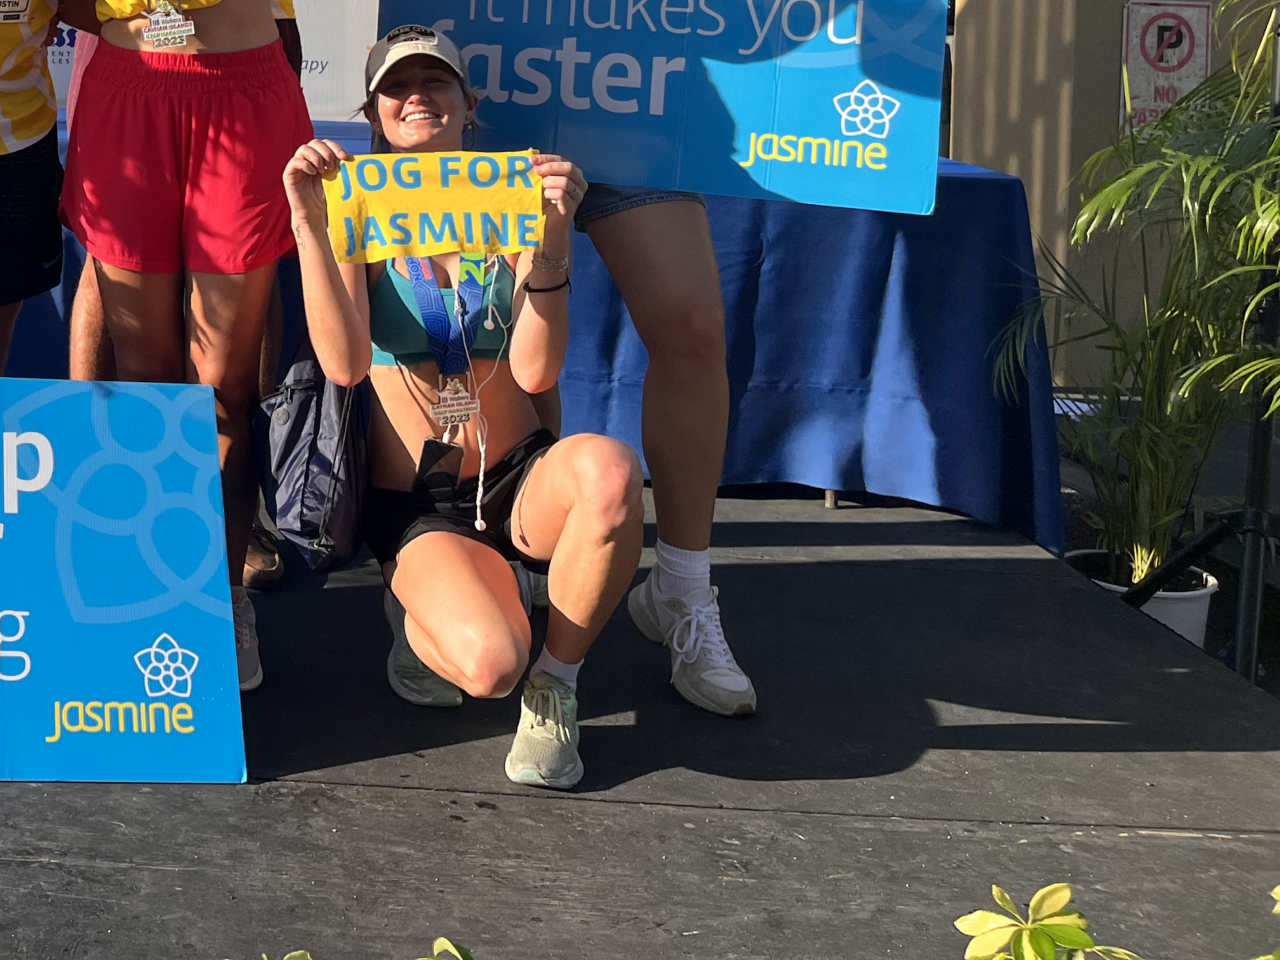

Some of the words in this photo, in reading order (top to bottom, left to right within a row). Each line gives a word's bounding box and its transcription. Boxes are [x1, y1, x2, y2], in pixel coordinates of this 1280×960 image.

[154, 35, 186, 48] 2023
[1153, 85, 1178, 103] NO
[738, 130, 888, 170] jasmine
[338, 156, 423, 201] JOG
[439, 154, 534, 189] FOR
[343, 211, 540, 257] JASMINE
[441, 413, 471, 425] 2023
[45, 699, 196, 743] jasmine
